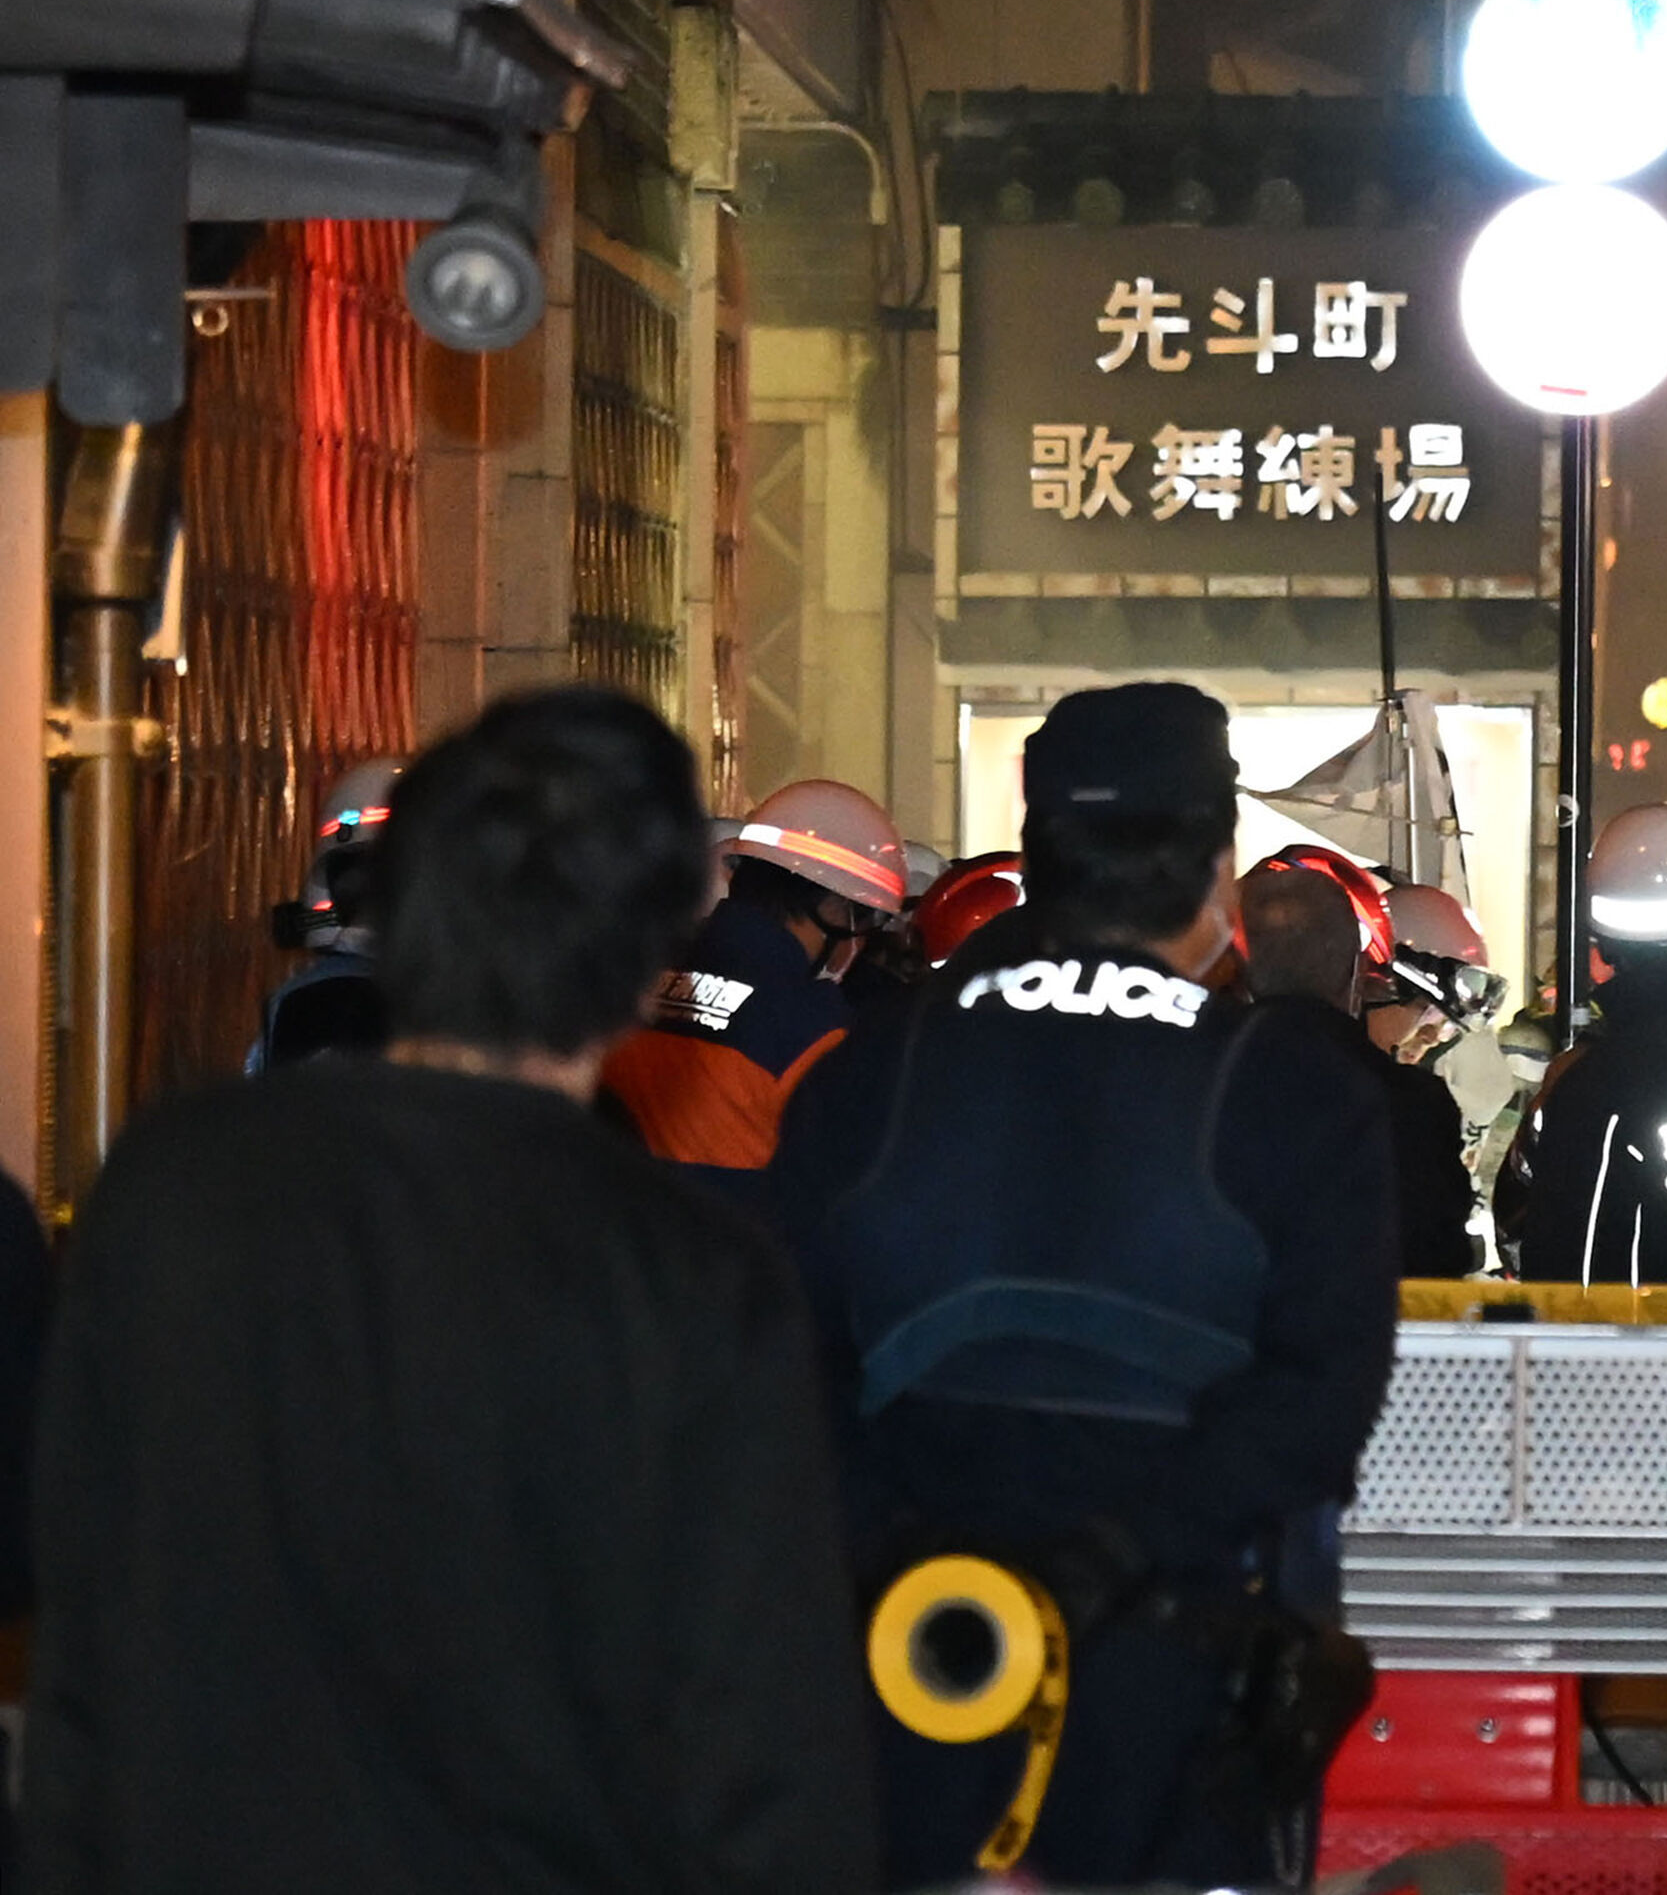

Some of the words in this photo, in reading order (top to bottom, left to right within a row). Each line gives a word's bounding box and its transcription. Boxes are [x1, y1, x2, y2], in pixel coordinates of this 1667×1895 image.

[1096, 276, 1408, 374] 先斗町
[1030, 423, 1471, 523] 歌舞練場
[958, 959, 1209, 1029] POLICE
